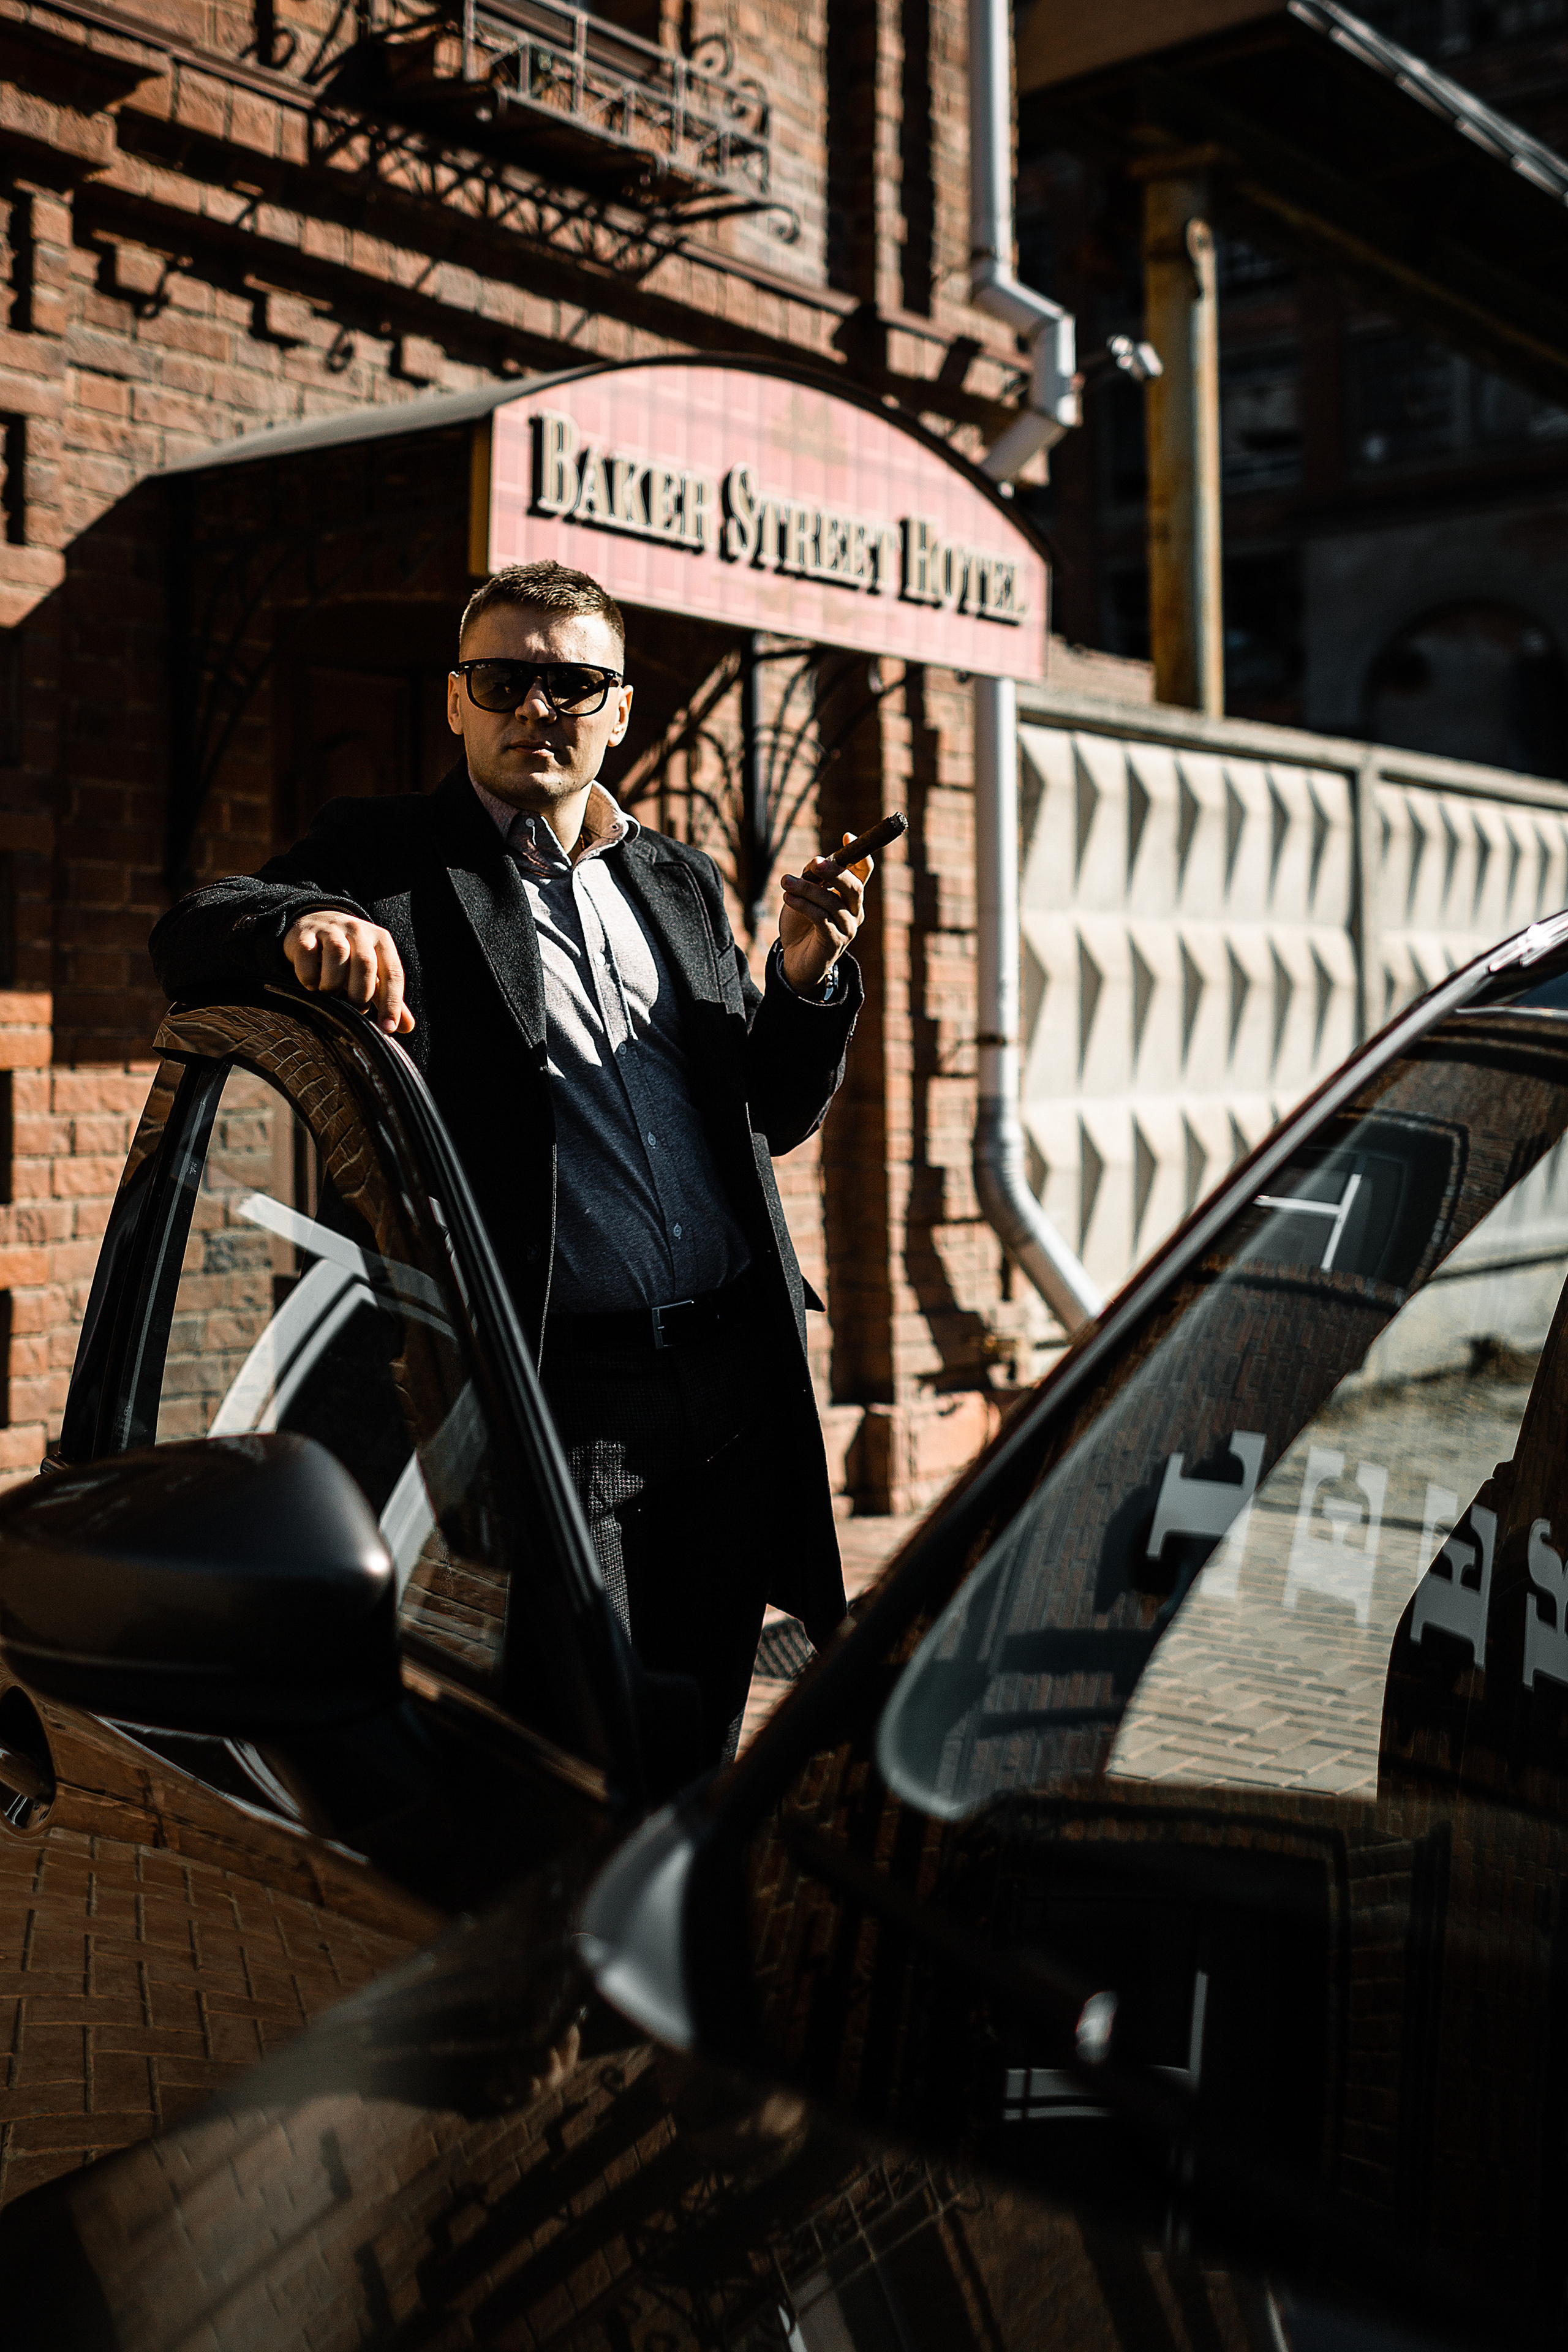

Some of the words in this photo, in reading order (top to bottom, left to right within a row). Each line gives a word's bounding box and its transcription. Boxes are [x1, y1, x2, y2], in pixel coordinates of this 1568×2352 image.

[529, 410, 718, 554] BAKER
[720, 461, 898, 594] STREET
[898, 514, 1030, 626] HOTEL
